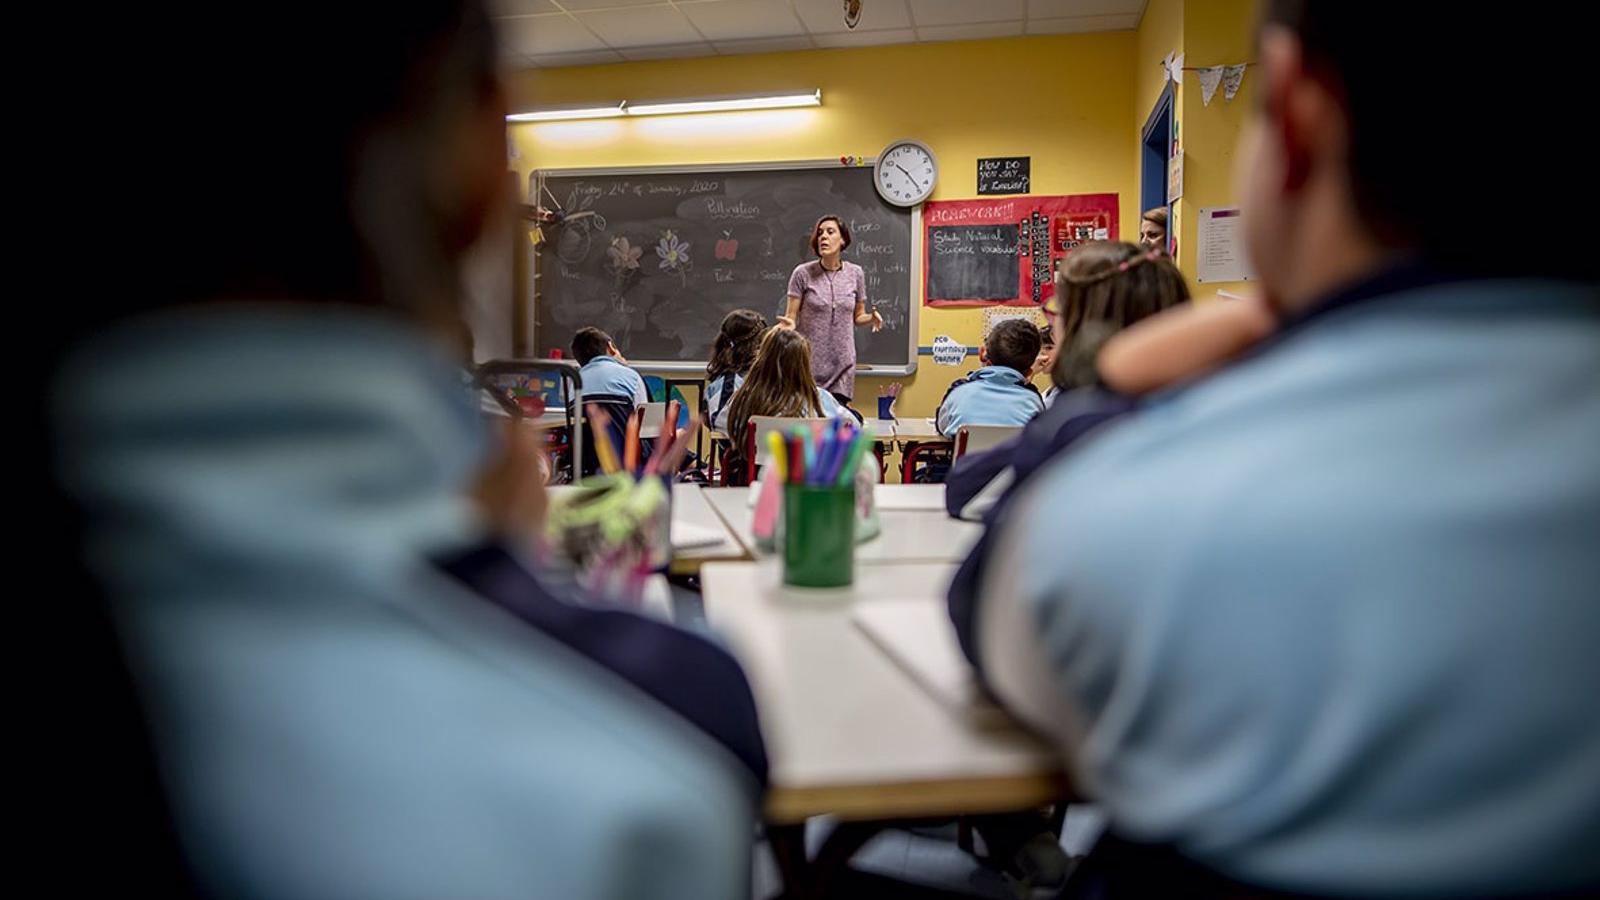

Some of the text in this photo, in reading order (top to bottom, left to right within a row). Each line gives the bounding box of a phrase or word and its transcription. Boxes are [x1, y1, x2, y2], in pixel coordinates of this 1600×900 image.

[980, 161, 1020, 170] HOW DO
[934, 229, 1005, 246] Study Natural
[935, 243, 975, 255] Science
